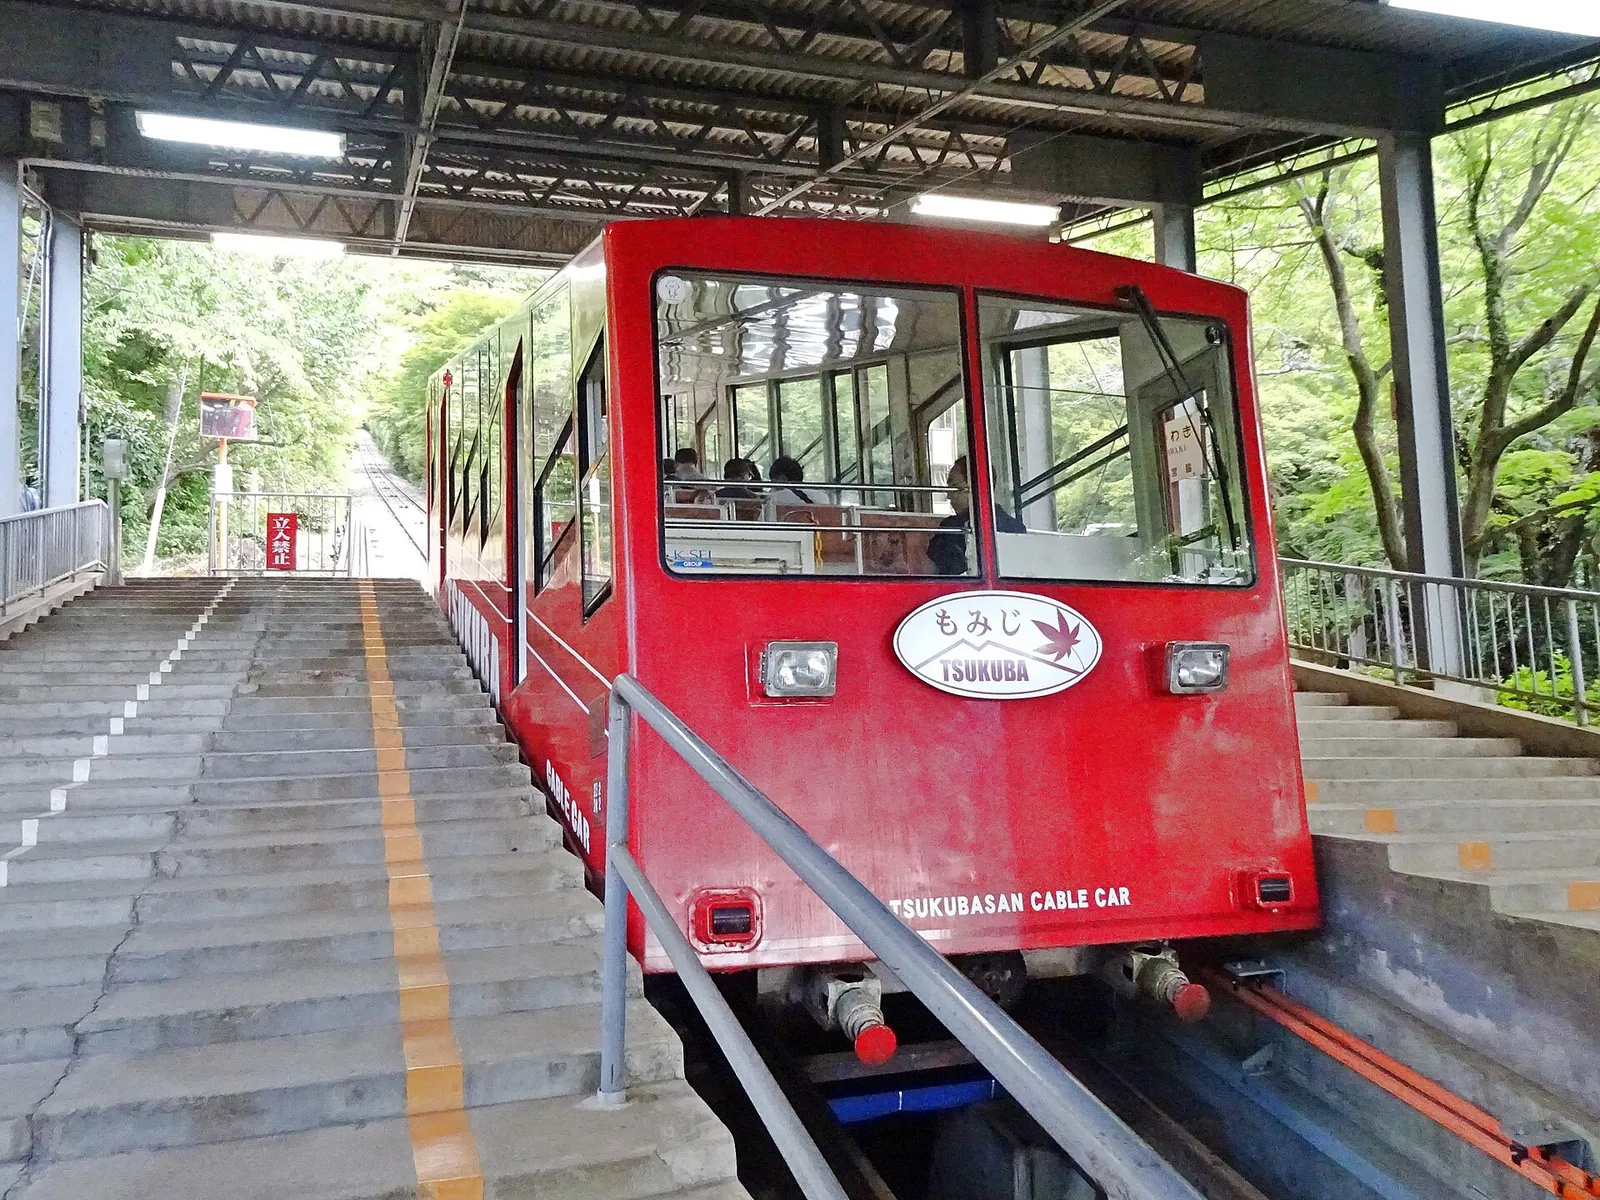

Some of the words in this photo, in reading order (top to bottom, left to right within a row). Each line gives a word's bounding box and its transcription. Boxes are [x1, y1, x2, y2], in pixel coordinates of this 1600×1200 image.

[272, 517, 290, 565] 立入禁止
[935, 608, 1021, 637] もみじ
[940, 658, 1029, 682] TSUKUBA
[546, 759, 570, 822] CABLE
[571, 799, 590, 855] CAR
[889, 892, 1024, 919] TSUKUBASAN
[1030, 888, 1089, 911] CABLE
[1094, 886, 1131, 907] CAR
